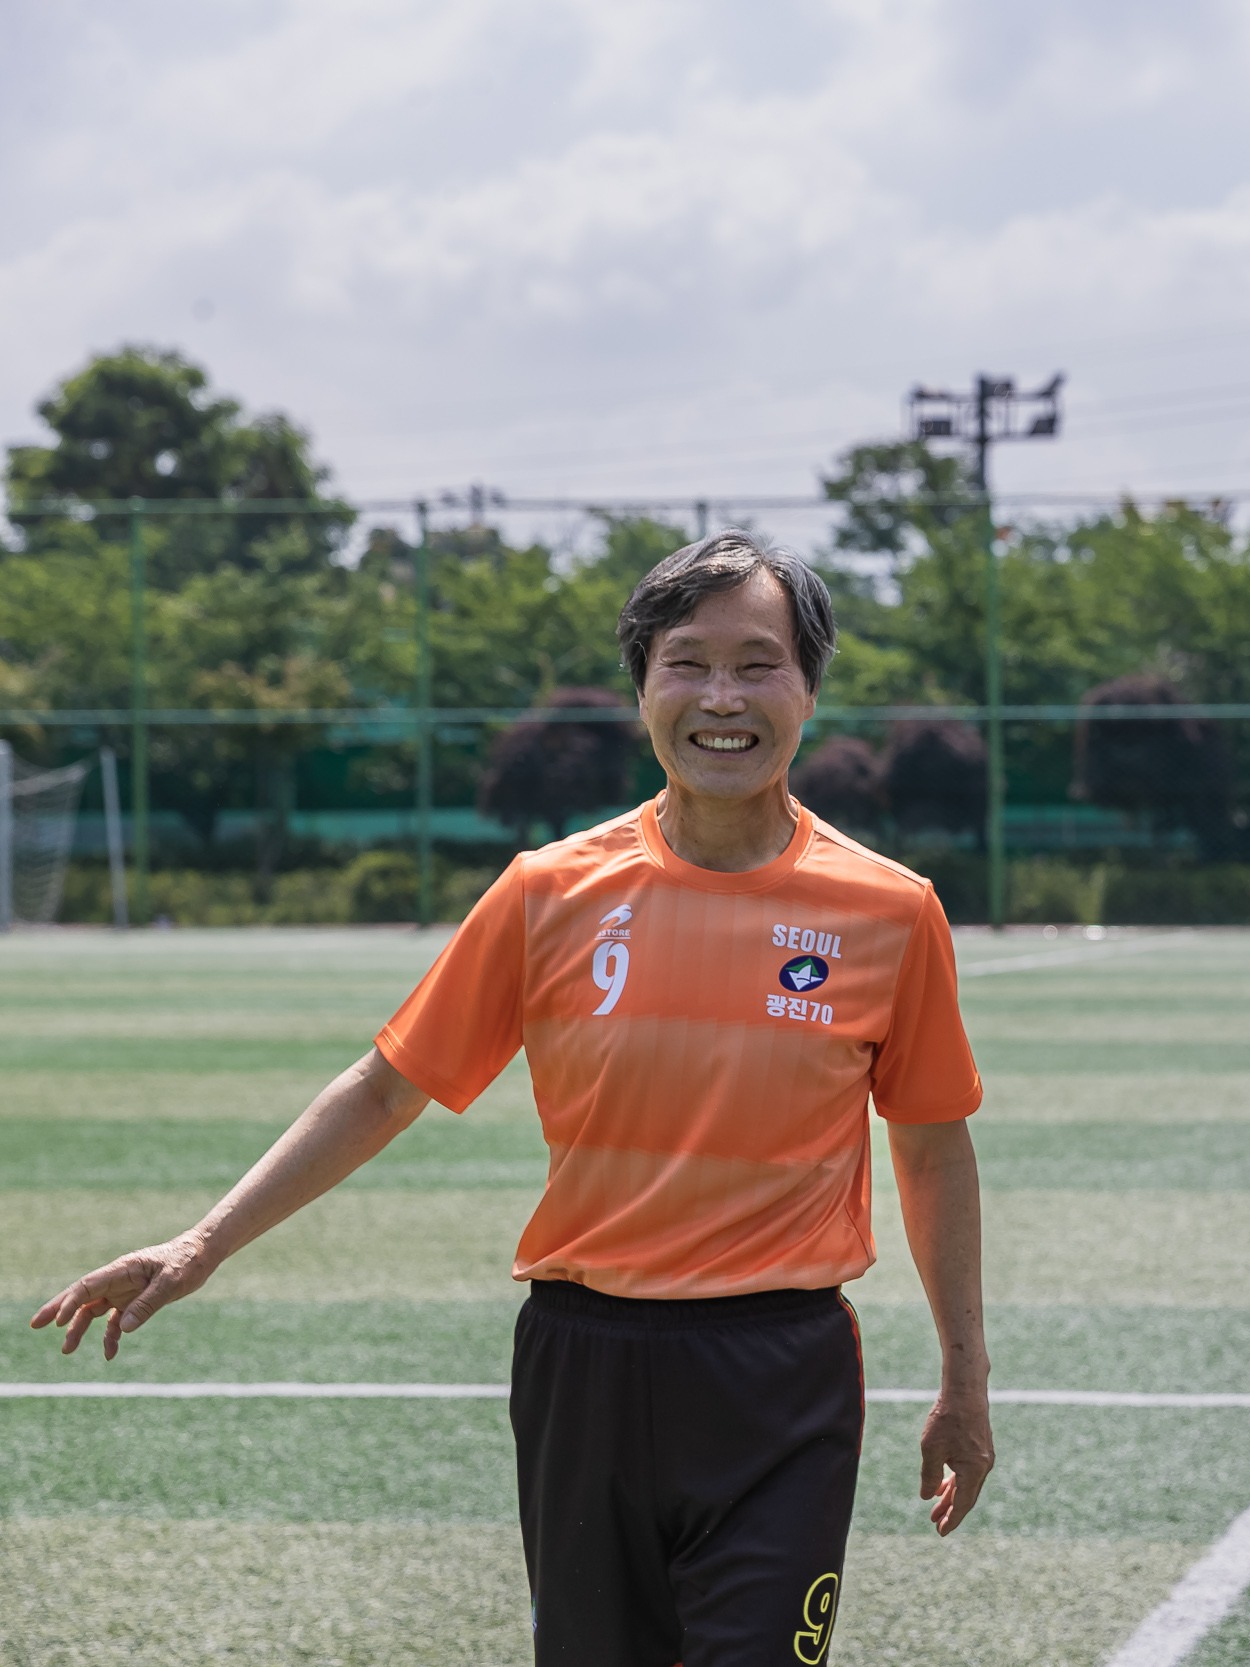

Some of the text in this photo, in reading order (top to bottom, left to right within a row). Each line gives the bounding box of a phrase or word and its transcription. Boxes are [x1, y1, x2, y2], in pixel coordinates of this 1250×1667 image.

[772, 923, 842, 959] SEOUL
[592, 940, 630, 1016] 9
[766, 993, 834, 1025] 광진70
[793, 1572, 839, 1665] 9
